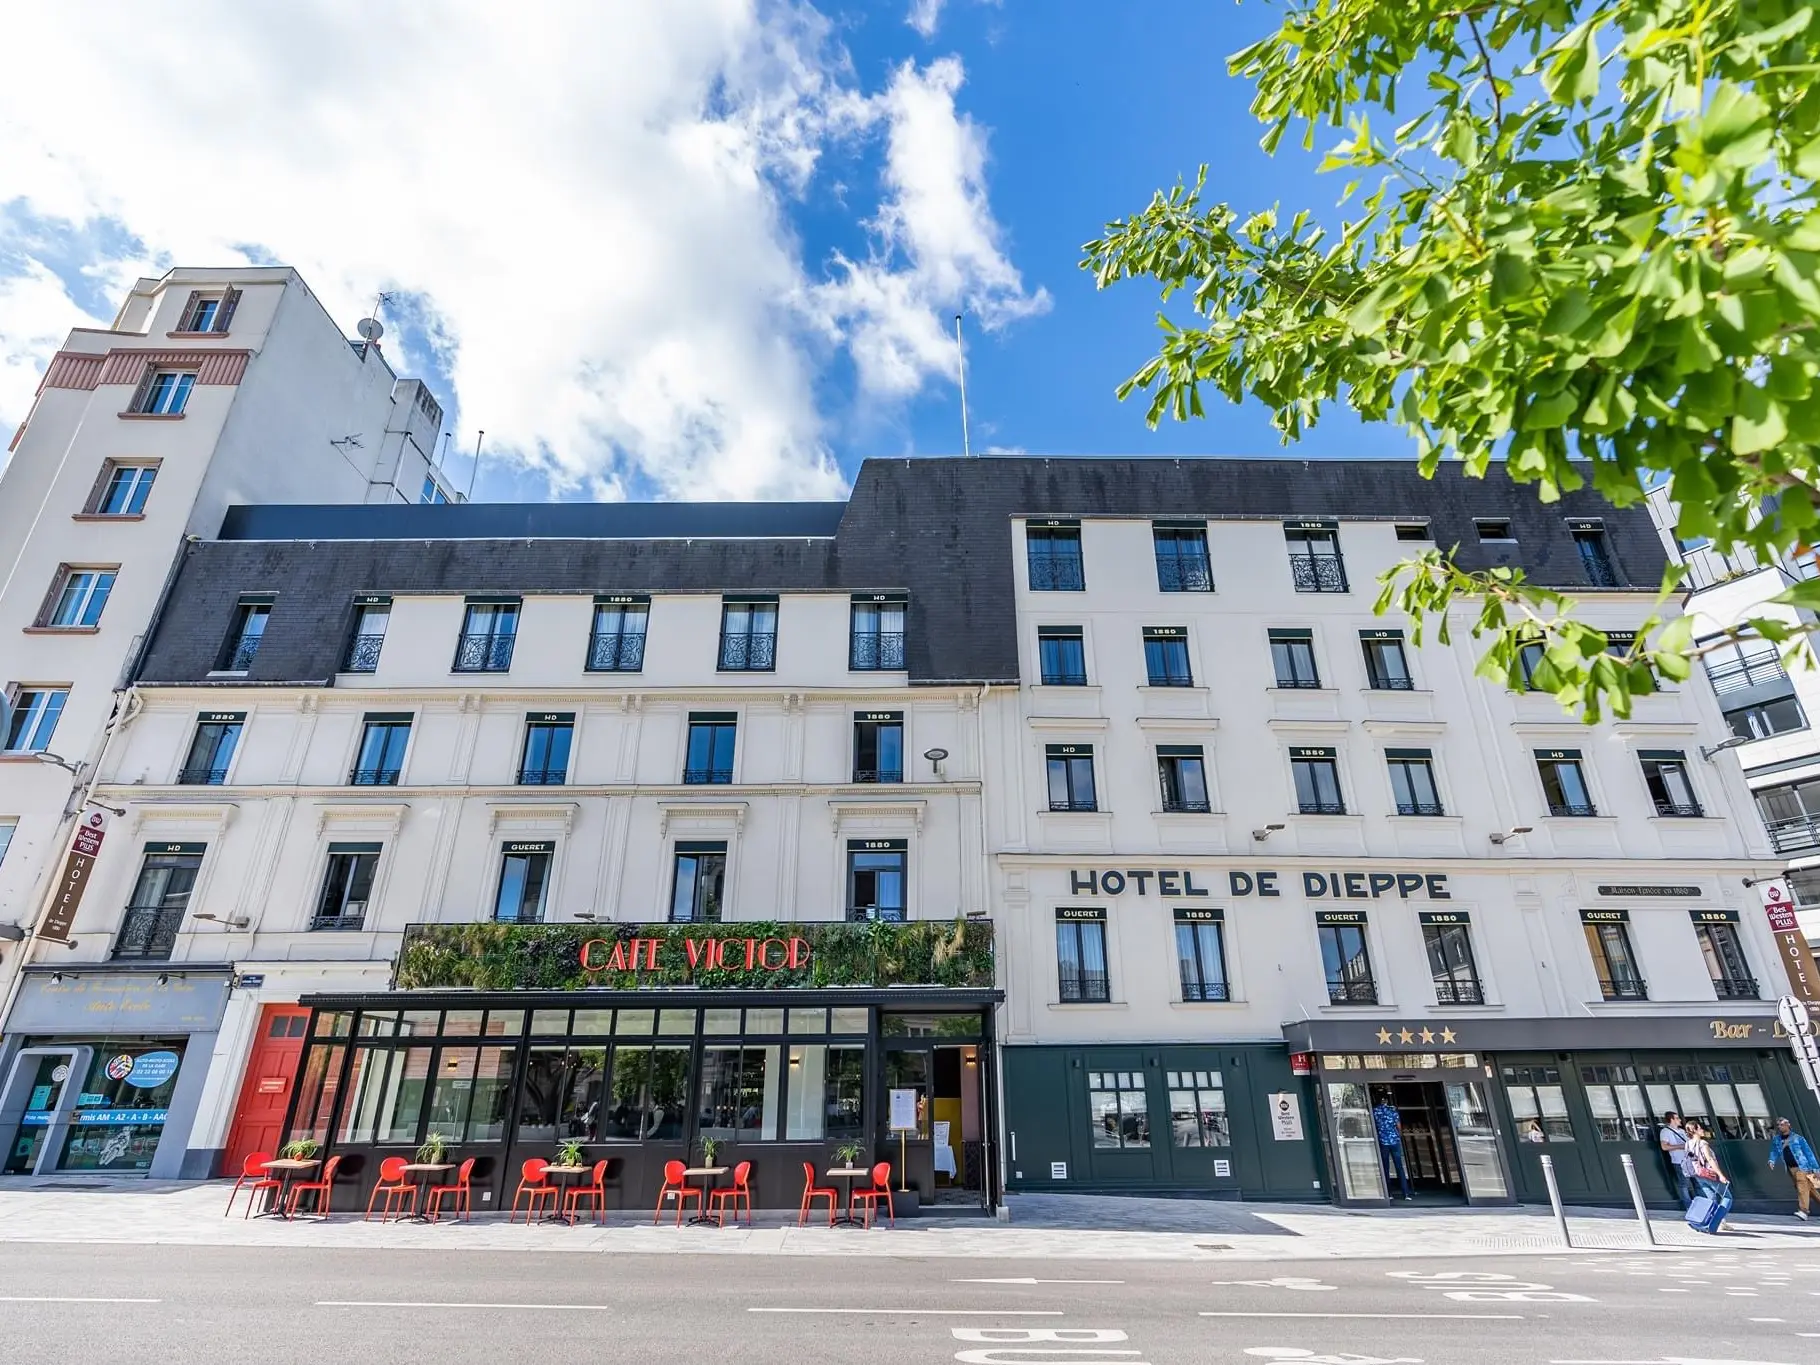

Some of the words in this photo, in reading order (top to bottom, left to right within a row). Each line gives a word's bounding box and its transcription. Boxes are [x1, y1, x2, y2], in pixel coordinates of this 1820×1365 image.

[167, 844, 181, 852] HD
[510, 843, 546, 851] GUERET
[58, 857, 85, 916] HOTEL
[1071, 870, 1209, 895] HOTEL
[1229, 871, 1280, 896] DE
[1302, 872, 1451, 899] DIEPPE
[1063, 910, 1099, 918] GUERET
[1773, 906, 1787, 914] Best
[1185, 911, 1212, 919] 1880
[1324, 913, 1359, 921] GUERET
[1430, 914, 1457, 922] 1880
[1769, 912, 1794, 920] Western
[1775, 918, 1794, 926] PLUS
[579, 938, 666, 971] CAFE
[685, 938, 811, 971] VICTOR
[1785, 934, 1812, 996] HOTEL
[1710, 1020, 1752, 1039] Bar
[96, 1113, 110, 1121] AM
[131, 1113, 137, 1121] A
[142, 1113, 148, 1121] B
